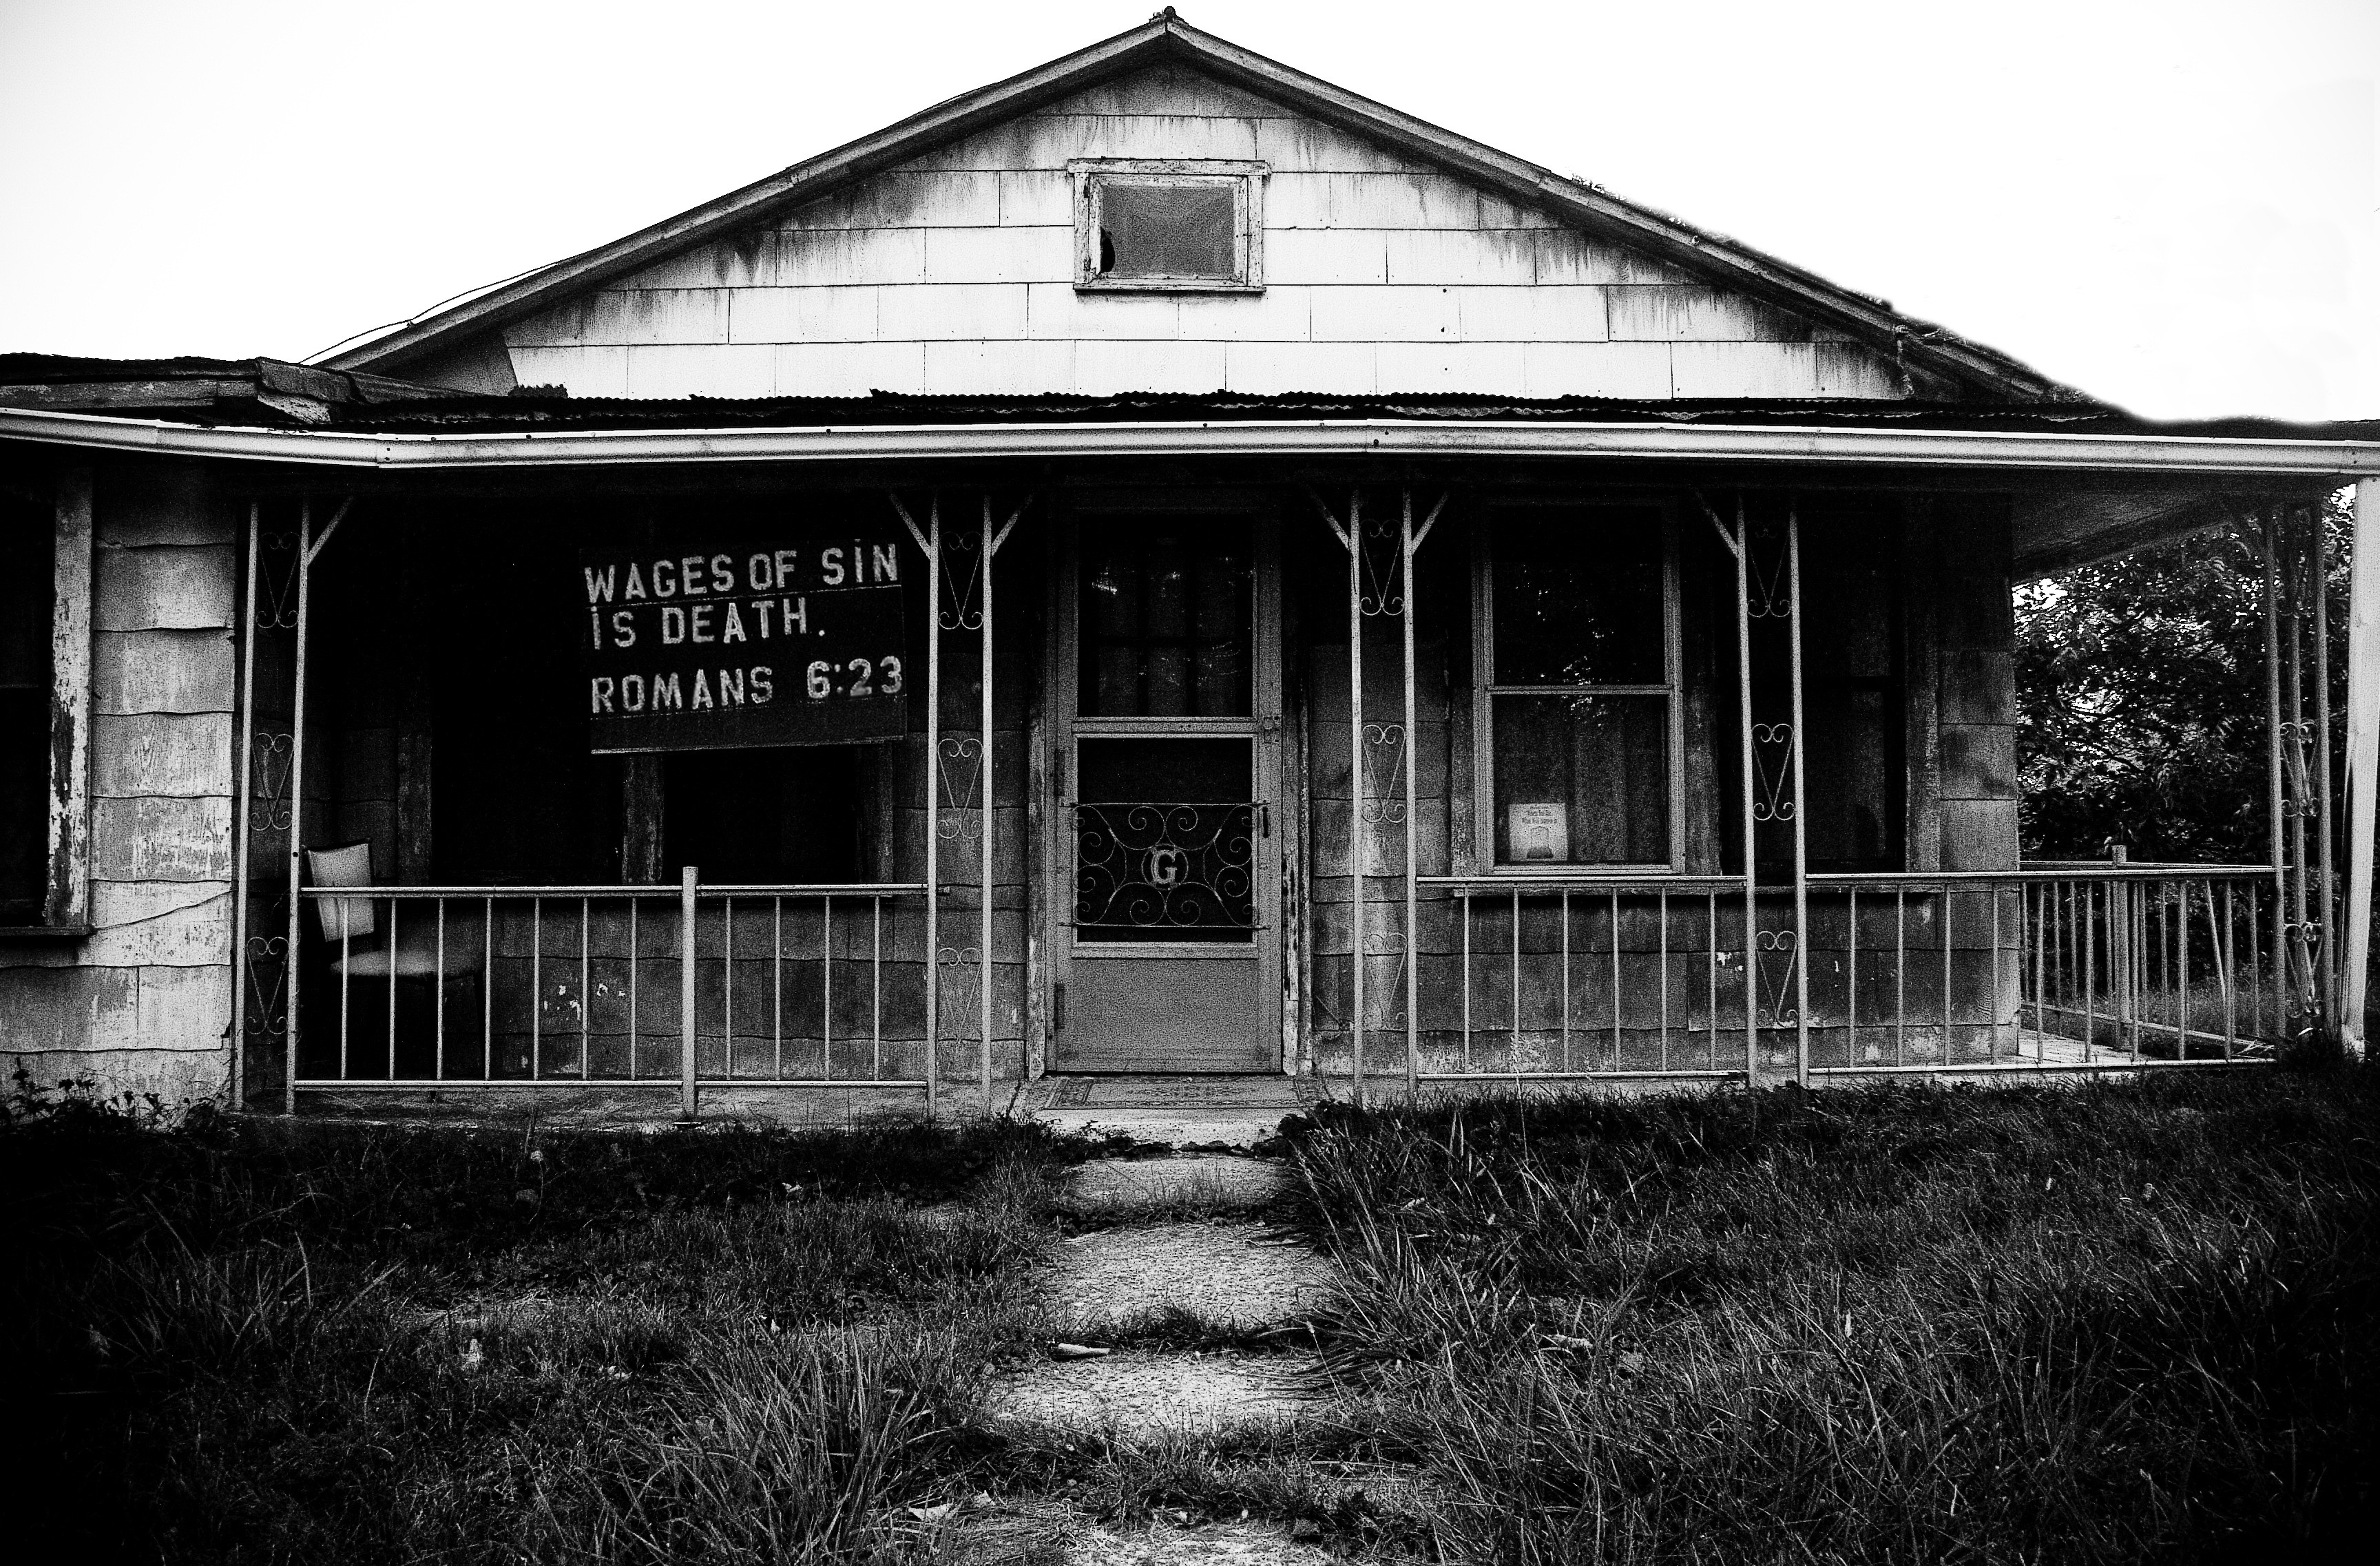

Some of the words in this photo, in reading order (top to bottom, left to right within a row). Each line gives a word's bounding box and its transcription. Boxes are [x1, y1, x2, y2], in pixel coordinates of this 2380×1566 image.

[585, 554, 735, 604] WAGES
[749, 550, 797, 591] OF
[662, 597, 826, 645] DEATH.
[592, 666, 773, 714] ROMANS
[806, 656, 904, 700] 6:23
[1151, 848, 1178, 886] G
